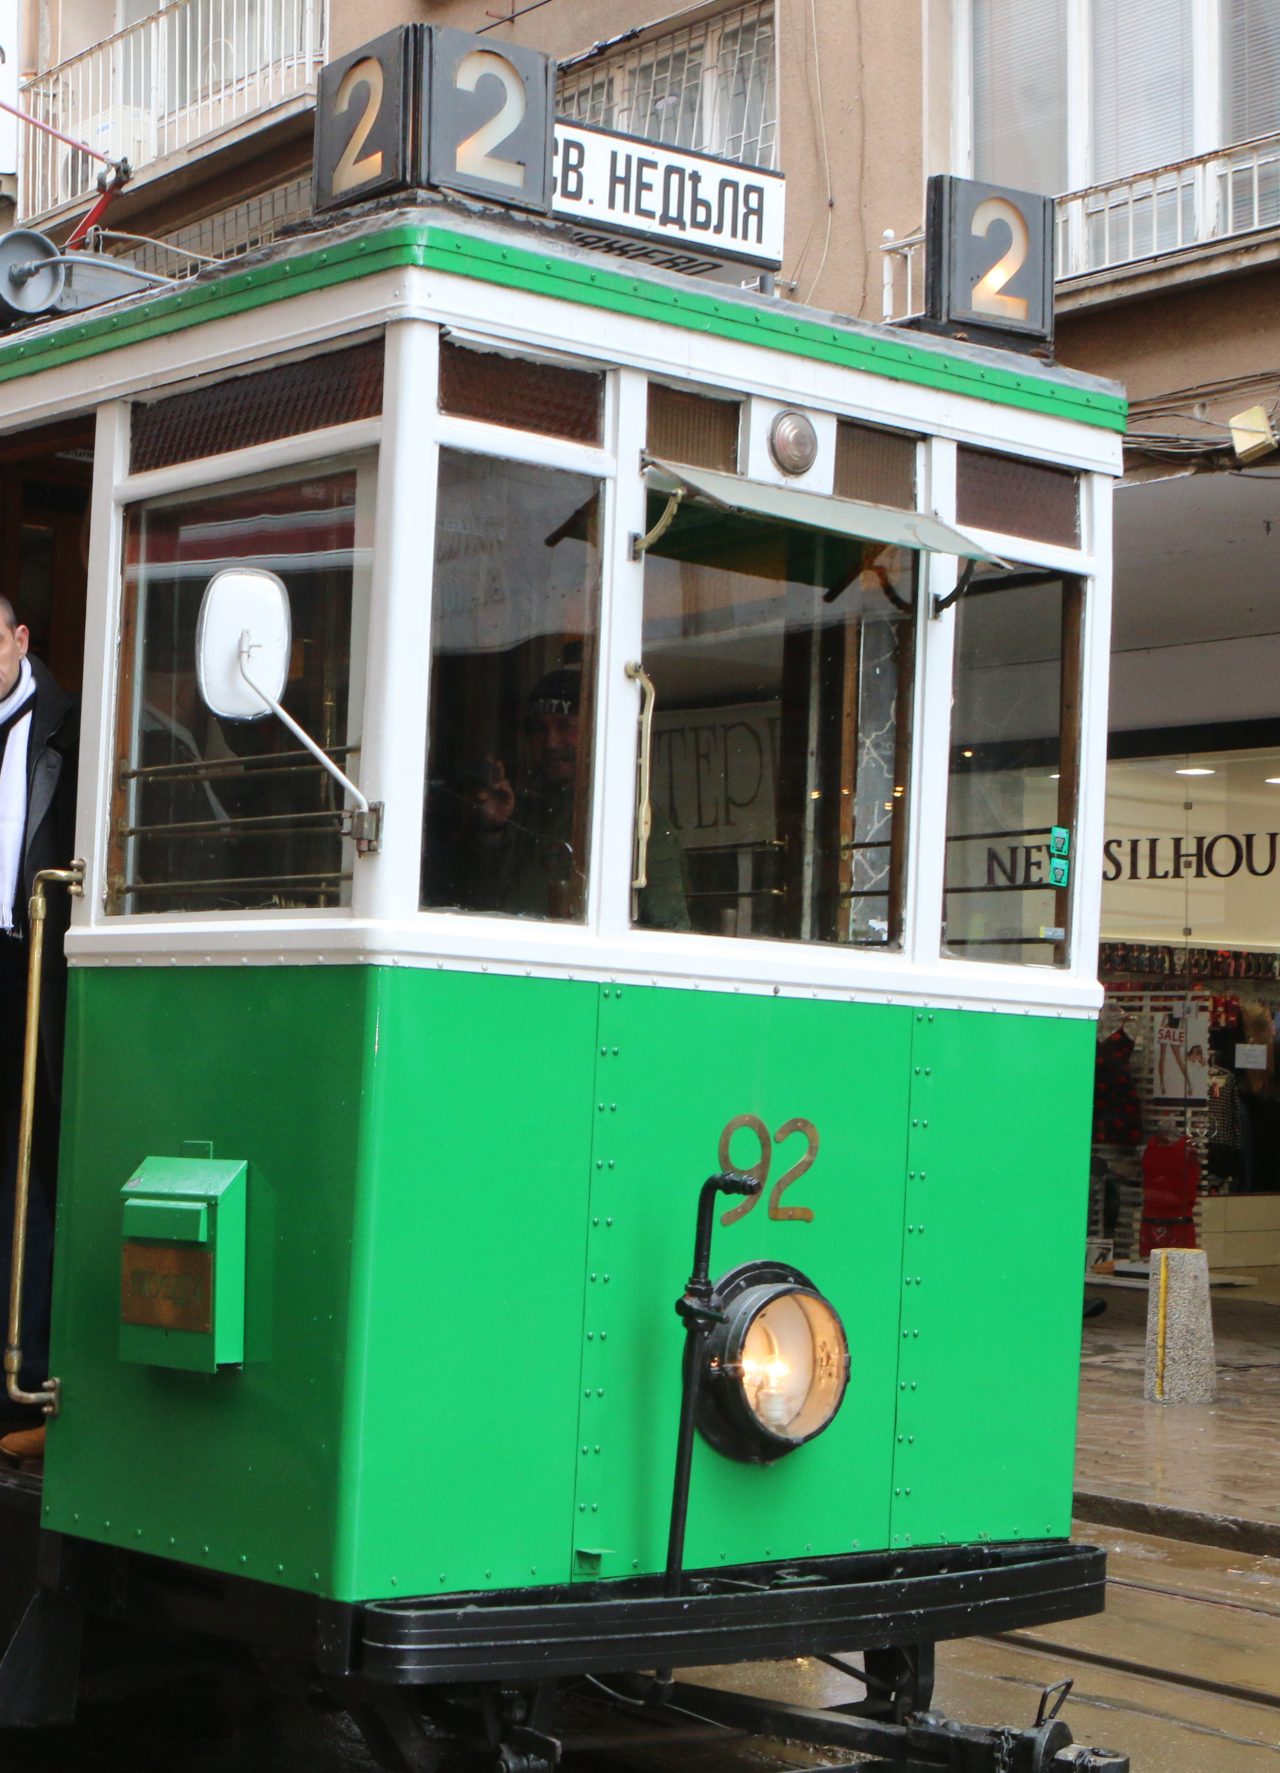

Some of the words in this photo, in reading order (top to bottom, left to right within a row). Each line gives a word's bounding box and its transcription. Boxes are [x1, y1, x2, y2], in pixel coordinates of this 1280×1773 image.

[332, 56, 385, 192] 2
[455, 50, 527, 187] 2
[553, 136, 594, 205] В.
[971, 197, 1029, 320] 2
[1103, 832, 1280, 881] SILHOU
[1158, 1028, 1185, 1043] SALE
[718, 1114, 820, 1227] 92
